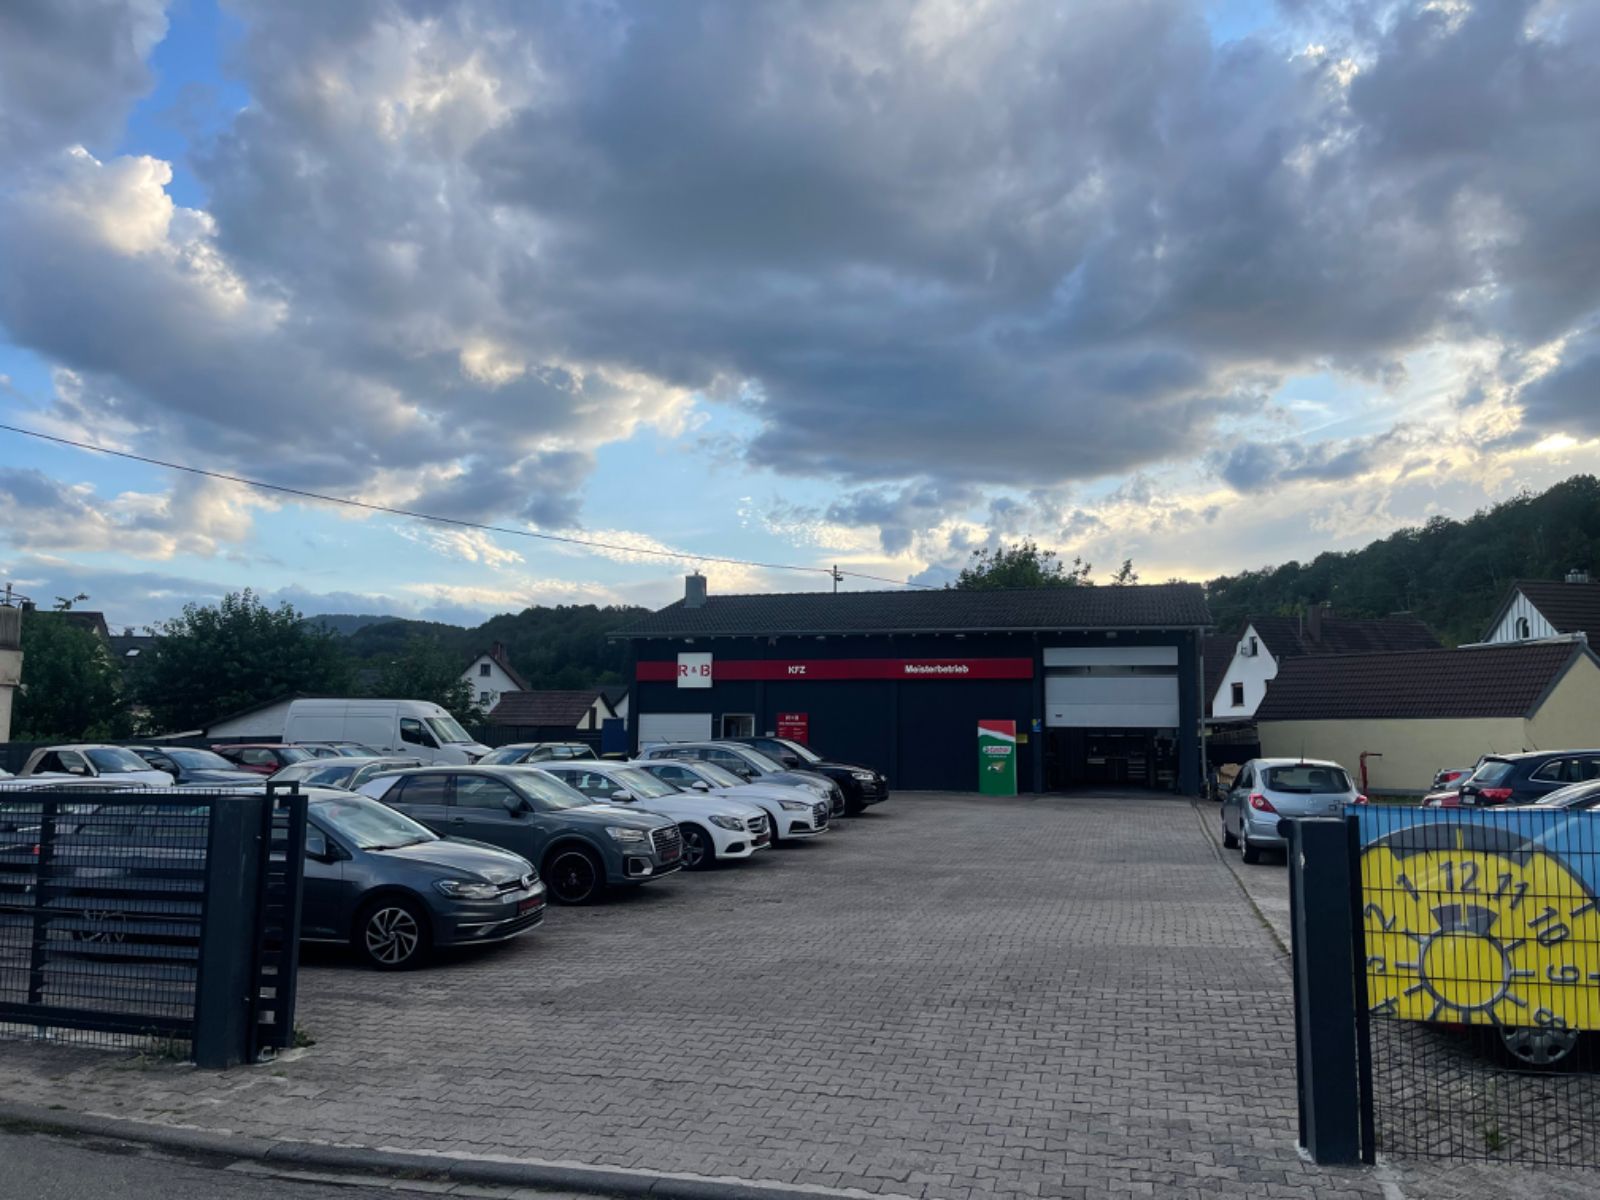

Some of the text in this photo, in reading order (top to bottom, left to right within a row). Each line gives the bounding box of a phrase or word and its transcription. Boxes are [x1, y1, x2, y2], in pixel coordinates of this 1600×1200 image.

[679, 664, 688, 677] R
[701, 664, 710, 677] B
[788, 665, 806, 674] KFZ
[904, 664, 969, 674] Meisterbetrieb
[1396, 873, 1421, 902] 1
[1440, 860, 1481, 896] 12
[1493, 873, 1529, 910] 11
[1364, 903, 1397, 931] 2
[1527, 905, 1570, 947] 10
[1546, 963, 1580, 983] 9
